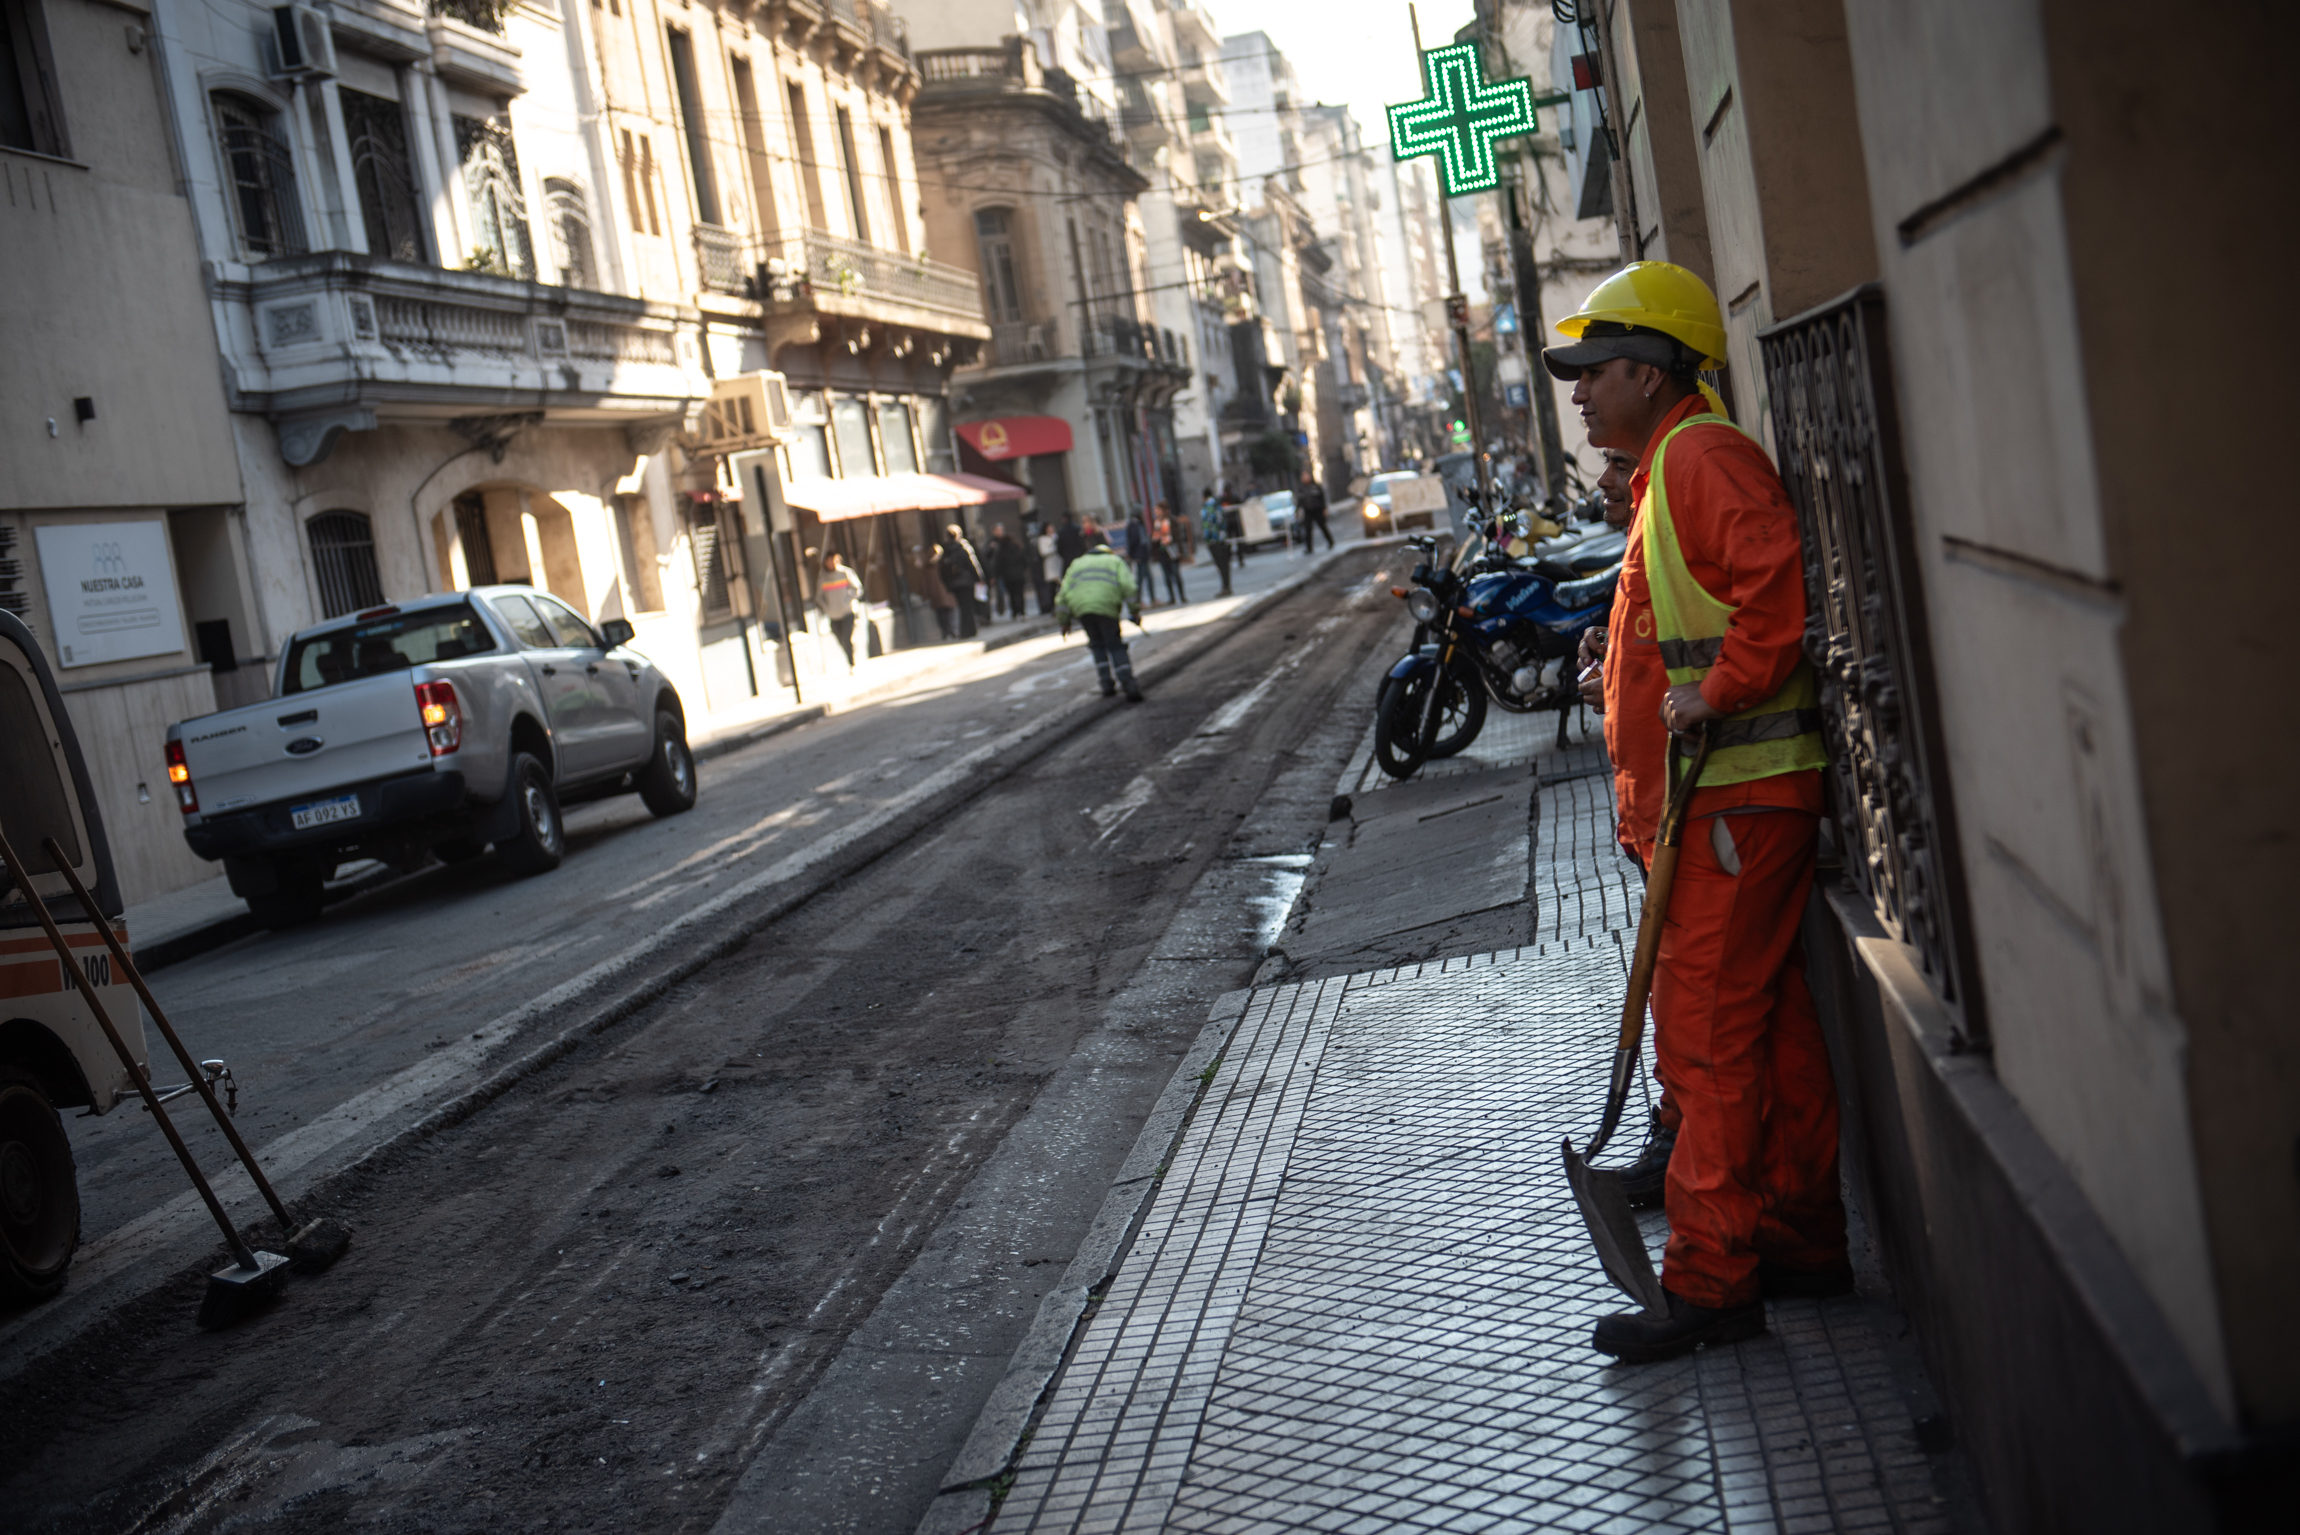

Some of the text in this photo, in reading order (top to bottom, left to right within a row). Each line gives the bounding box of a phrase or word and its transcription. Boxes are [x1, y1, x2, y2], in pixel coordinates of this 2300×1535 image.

[80, 575, 144, 593] NUESTRA CASA
[190, 725, 247, 744] RANGER
[296, 811, 311, 826] AF
[315, 806, 338, 822] 092
[341, 801, 357, 816] YS
[83, 954, 109, 988] 100
